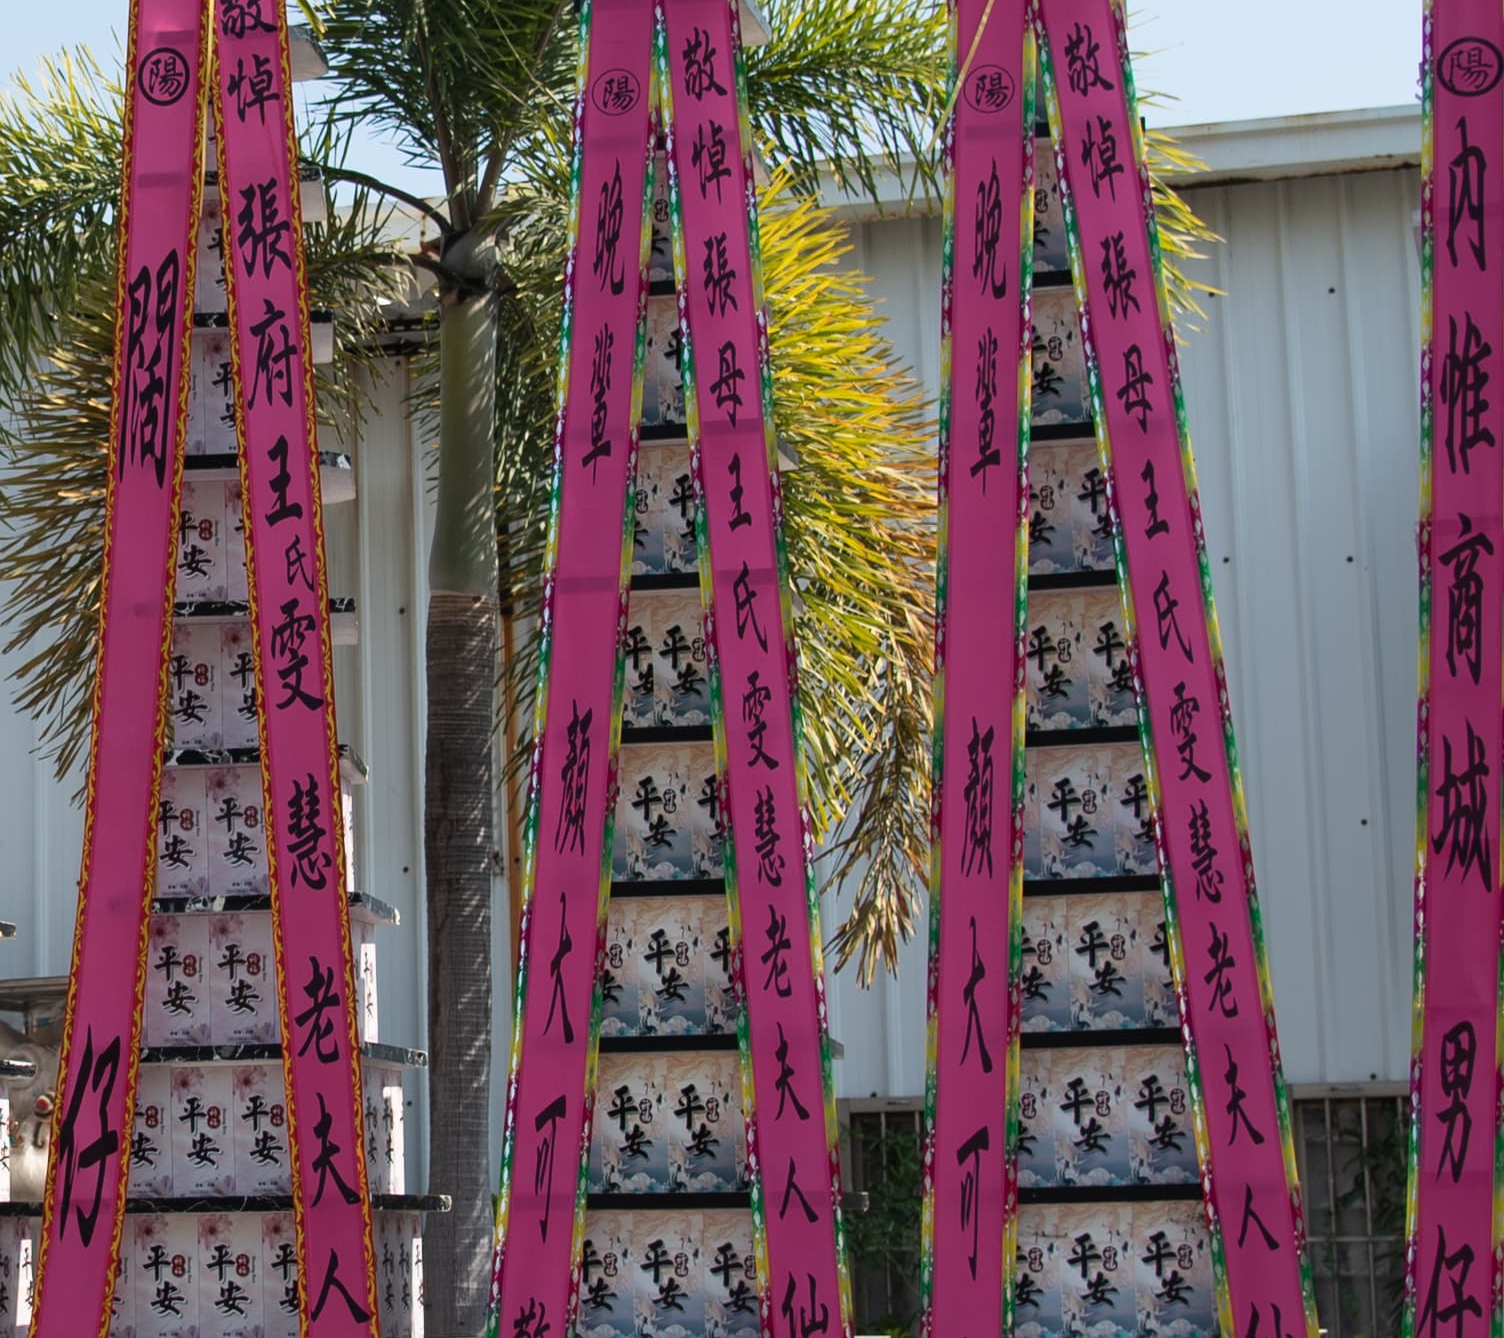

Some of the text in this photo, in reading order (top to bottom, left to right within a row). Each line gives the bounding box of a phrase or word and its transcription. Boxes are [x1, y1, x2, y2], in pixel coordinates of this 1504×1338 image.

[631, 774, 676, 851] 平安
[156, 946, 196, 1014] 平安
[219, 944, 259, 1012] 平安
[644, 927, 689, 1004] 平安
[180, 1098, 220, 1166] 平安
[243, 1096, 283, 1164] 平安
[607, 1084, 652, 1161] 平安
[144, 1246, 184, 1314] 平安
[208, 1246, 248, 1314] 平安
[642, 1237, 687, 1314] 平安
